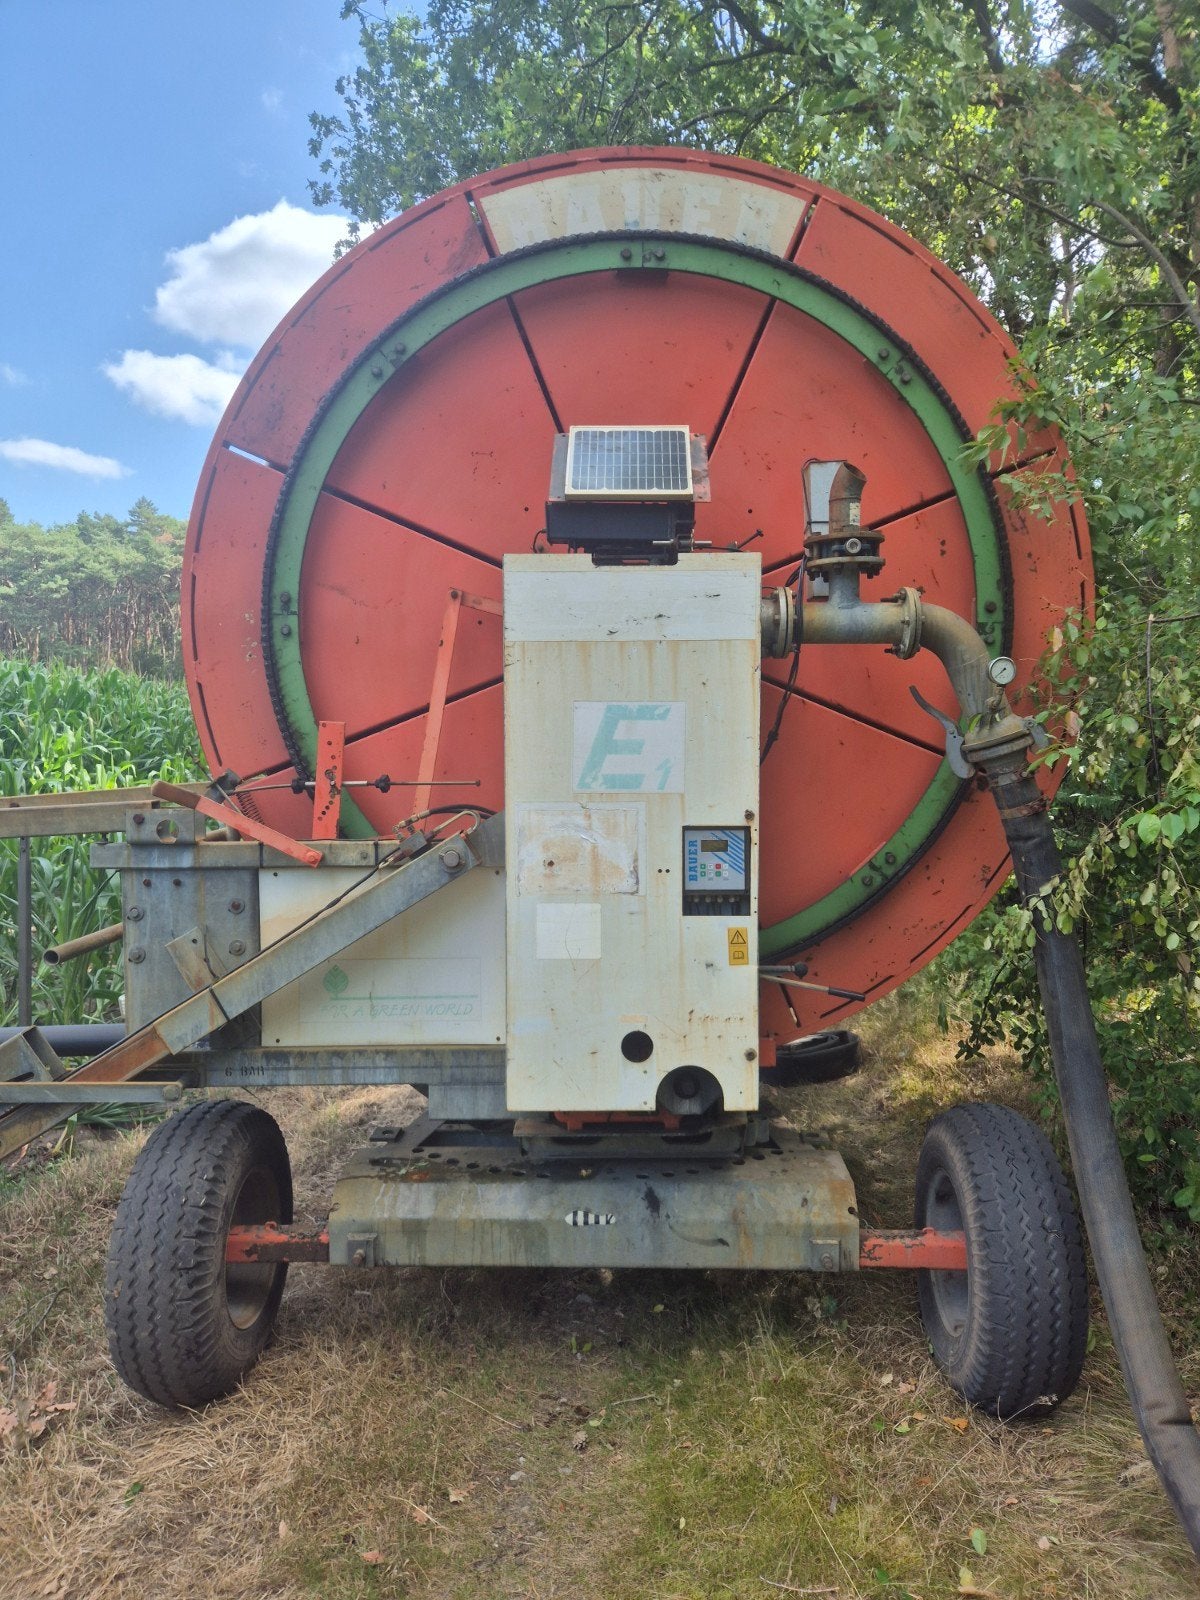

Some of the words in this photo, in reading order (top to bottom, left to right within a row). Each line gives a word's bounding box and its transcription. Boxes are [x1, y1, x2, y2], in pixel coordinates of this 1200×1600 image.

[688, 840, 698, 881] BAUER
[320, 1004, 349, 1018] FOR
[353, 1005, 364, 1017] A
[370, 1003, 419, 1017] GREEN
[425, 1003, 473, 1016] WORLD
[241, 1066, 264, 1077] BAR
